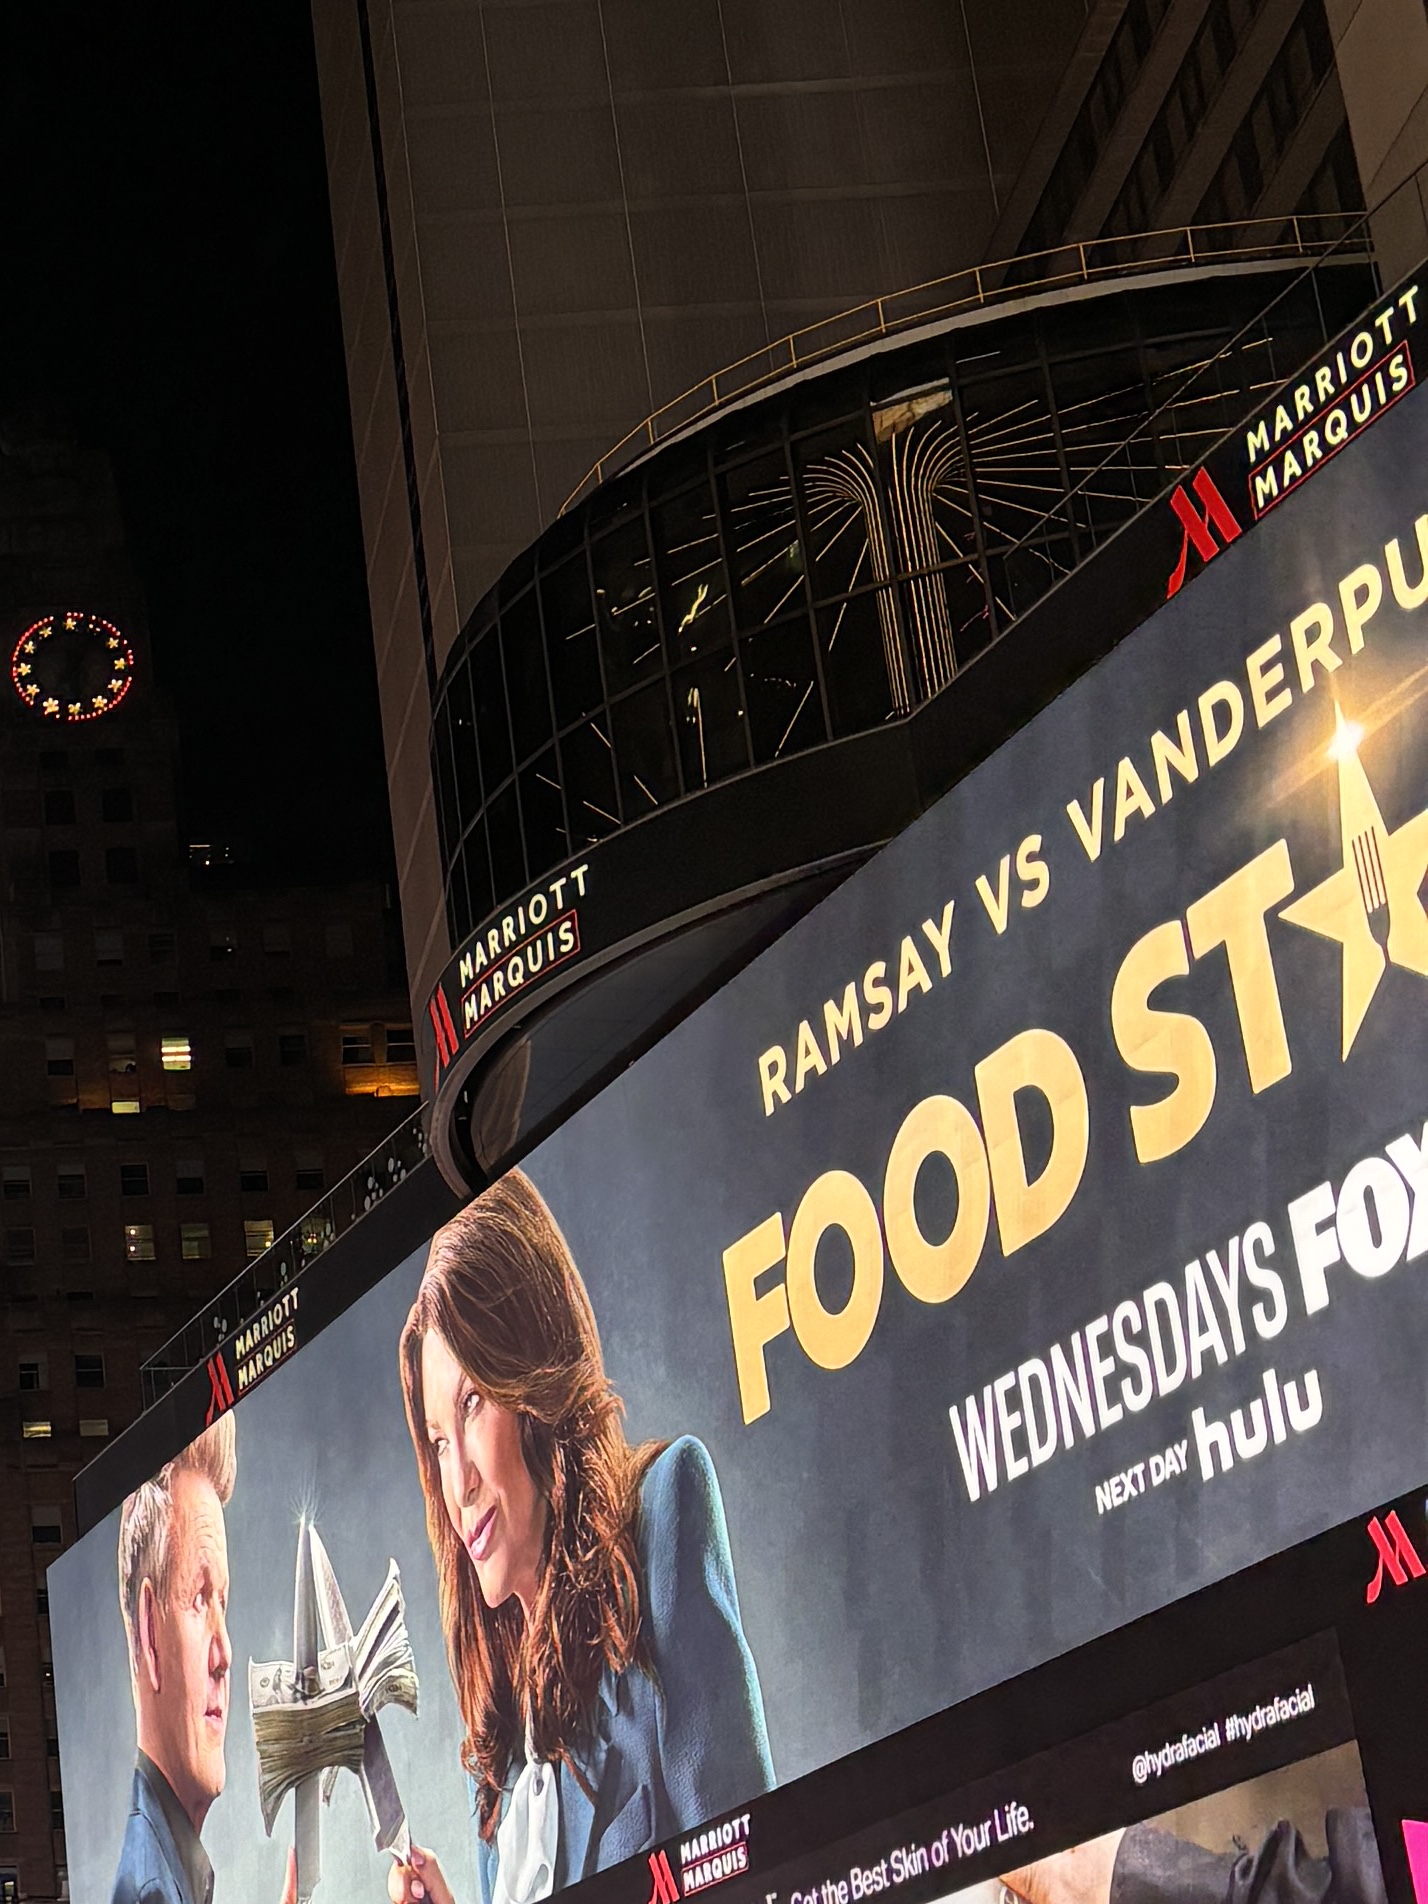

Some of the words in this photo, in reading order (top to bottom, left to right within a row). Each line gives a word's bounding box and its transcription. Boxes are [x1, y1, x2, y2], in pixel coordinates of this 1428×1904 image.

[1245, 283, 1424, 463] MARRIOTT
[1253, 351, 1414, 512] MARQUIS
[458, 862, 590, 982] MARRIOTT
[463, 917, 578, 1032] MARQUIS
[757, 900, 957, 1117] RAMSAY
[975, 833, 1051, 938] VS
[722, 1027, 1090, 1426] FOOD
[235, 1286, 300, 1360] MARRIOTT
[238, 1325, 295, 1391] MARQUIS
[949, 1221, 1290, 1503] WEDNESDAYS
[1094, 1458, 1147, 1517] NEXT
[1149, 1438, 1190, 1487] DAY
[1194, 1367, 1324, 1484] hulu
[1131, 1722, 1222, 1786] @hydrafacial
[1225, 1683, 1315, 1747] #hydrafacial
[681, 1813, 752, 1864] MARRIOTT
[683, 1844, 748, 1892] MARQUIS
[849, 1858, 891, 1899] Best
[890, 1842, 929, 1885] Skin
[931, 1832, 950, 1867] of
[950, 1819, 992, 1858] Your
[992, 1799, 1035, 1843] Life.
